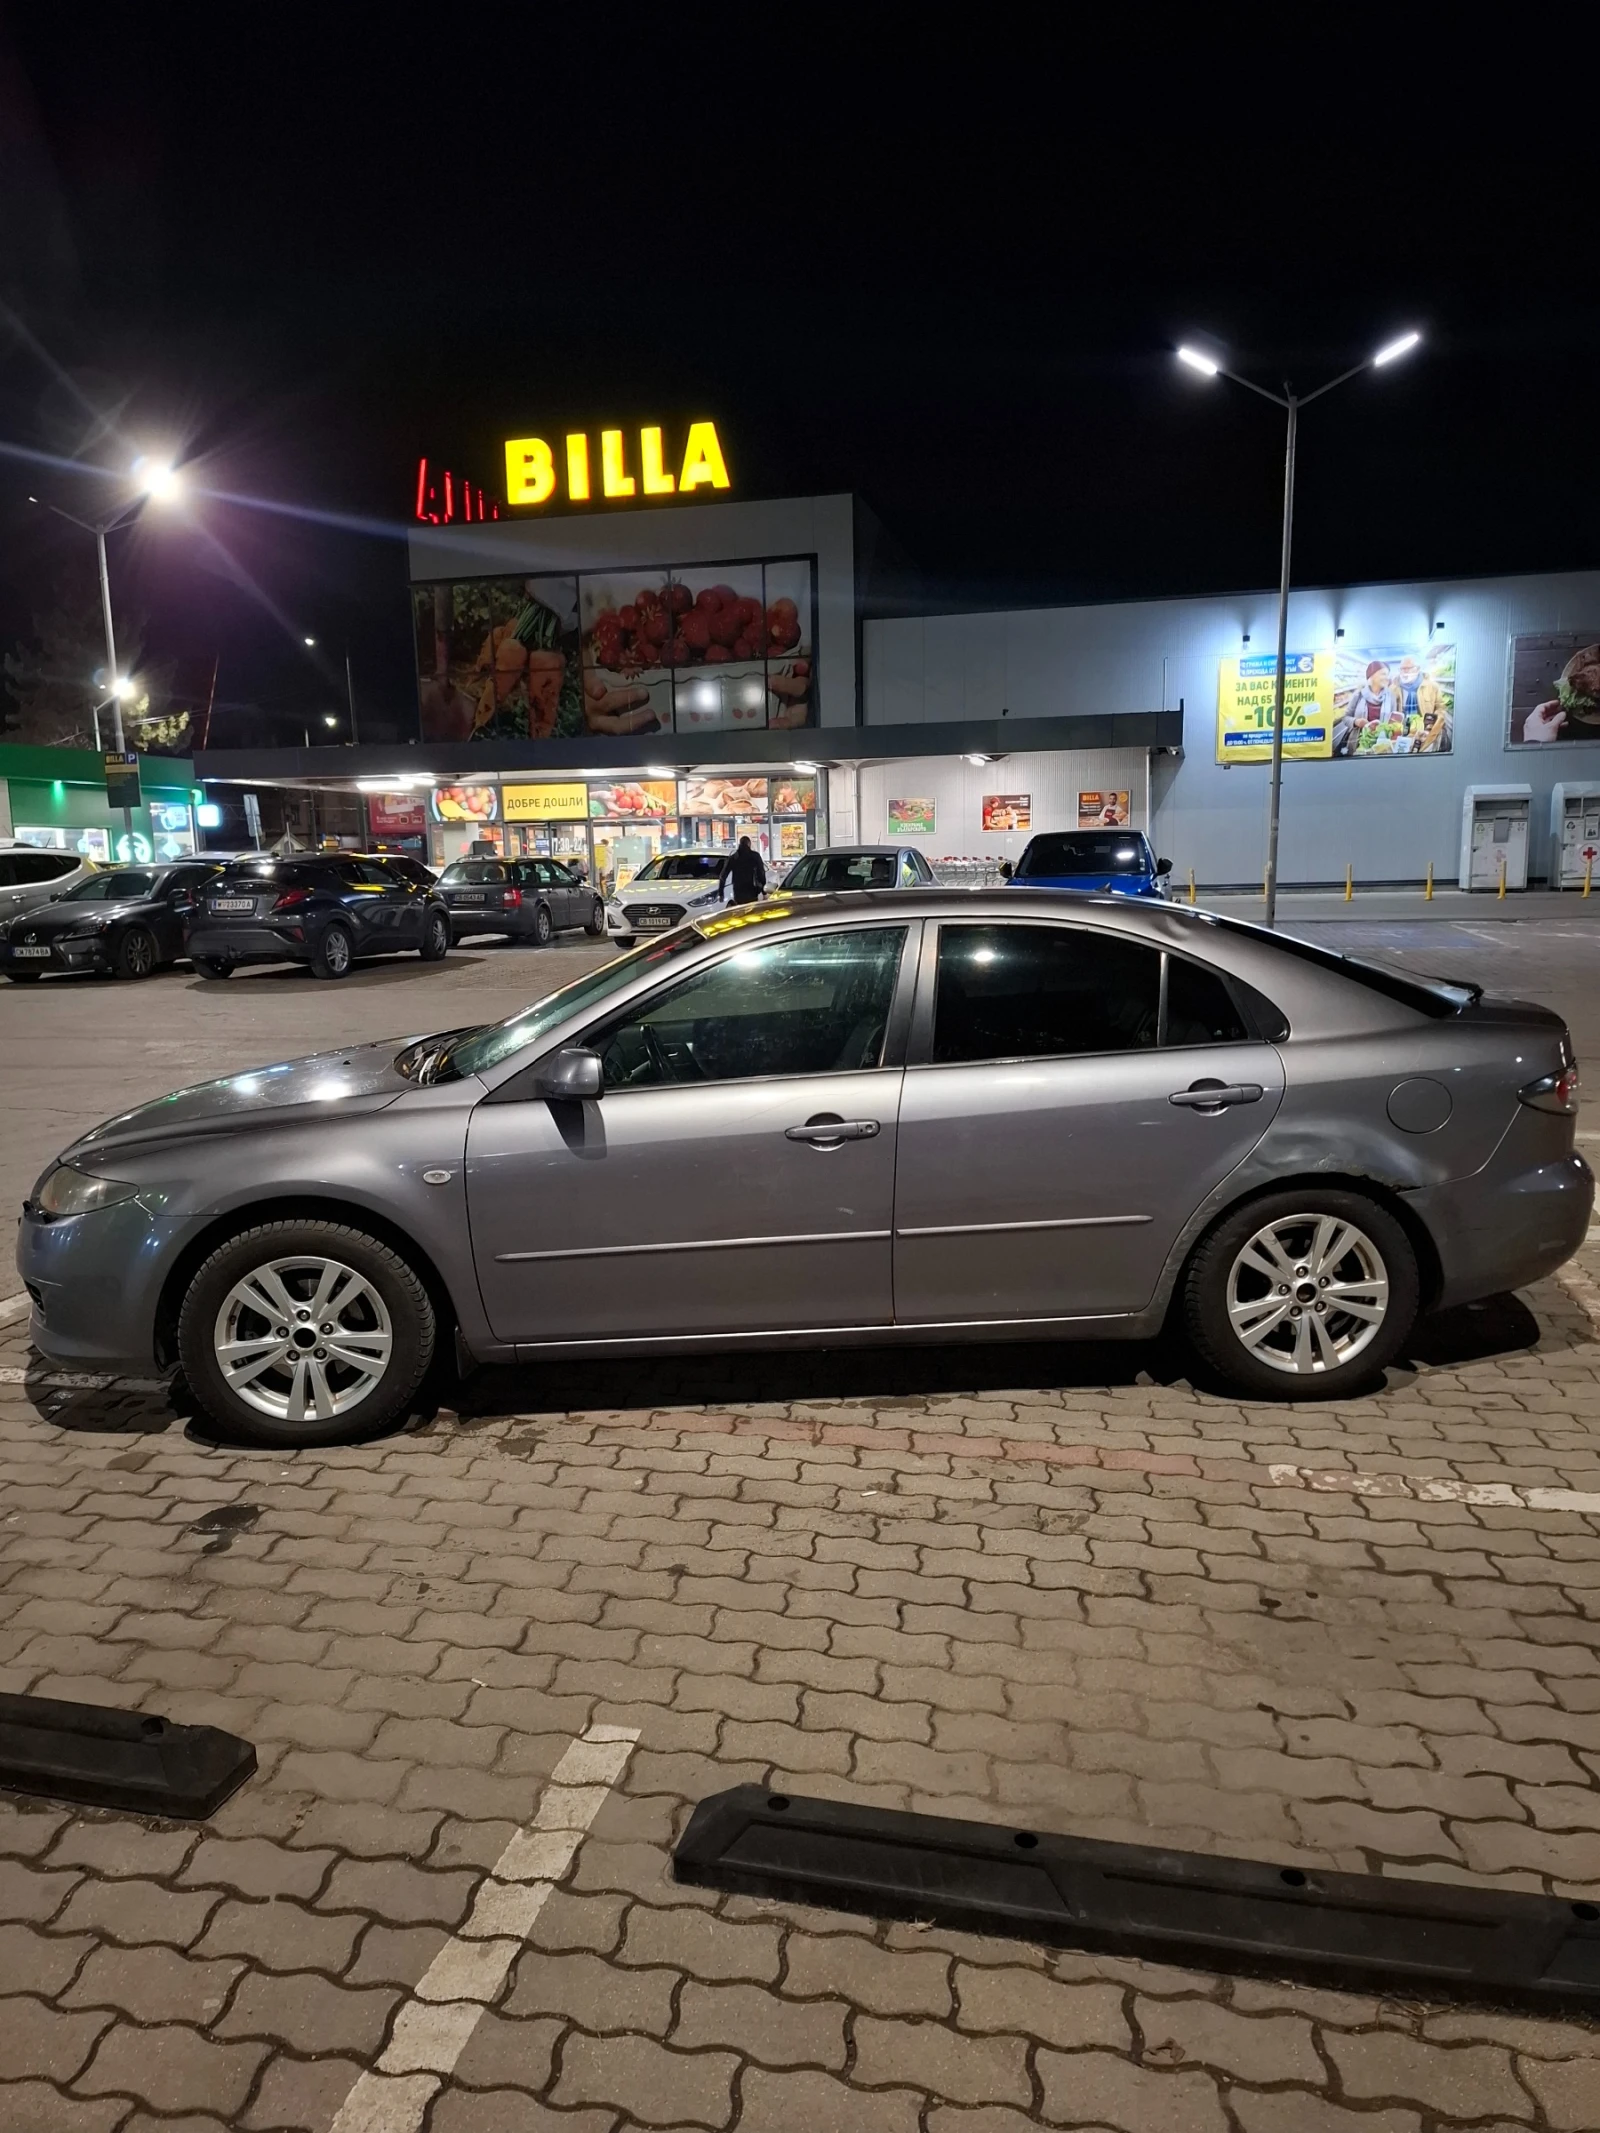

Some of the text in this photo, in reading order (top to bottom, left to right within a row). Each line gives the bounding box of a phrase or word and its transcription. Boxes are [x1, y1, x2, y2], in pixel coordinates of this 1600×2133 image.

[505, 422, 730, 505] BILLA
[1236, 678, 1318, 692] ЗА ВАС КИЕНТИ
[1237, 695, 1259, 706] НАД
[1261, 694, 1272, 704] 65
[507, 797, 583, 810] ДОБРЕ ДОШЛИ
